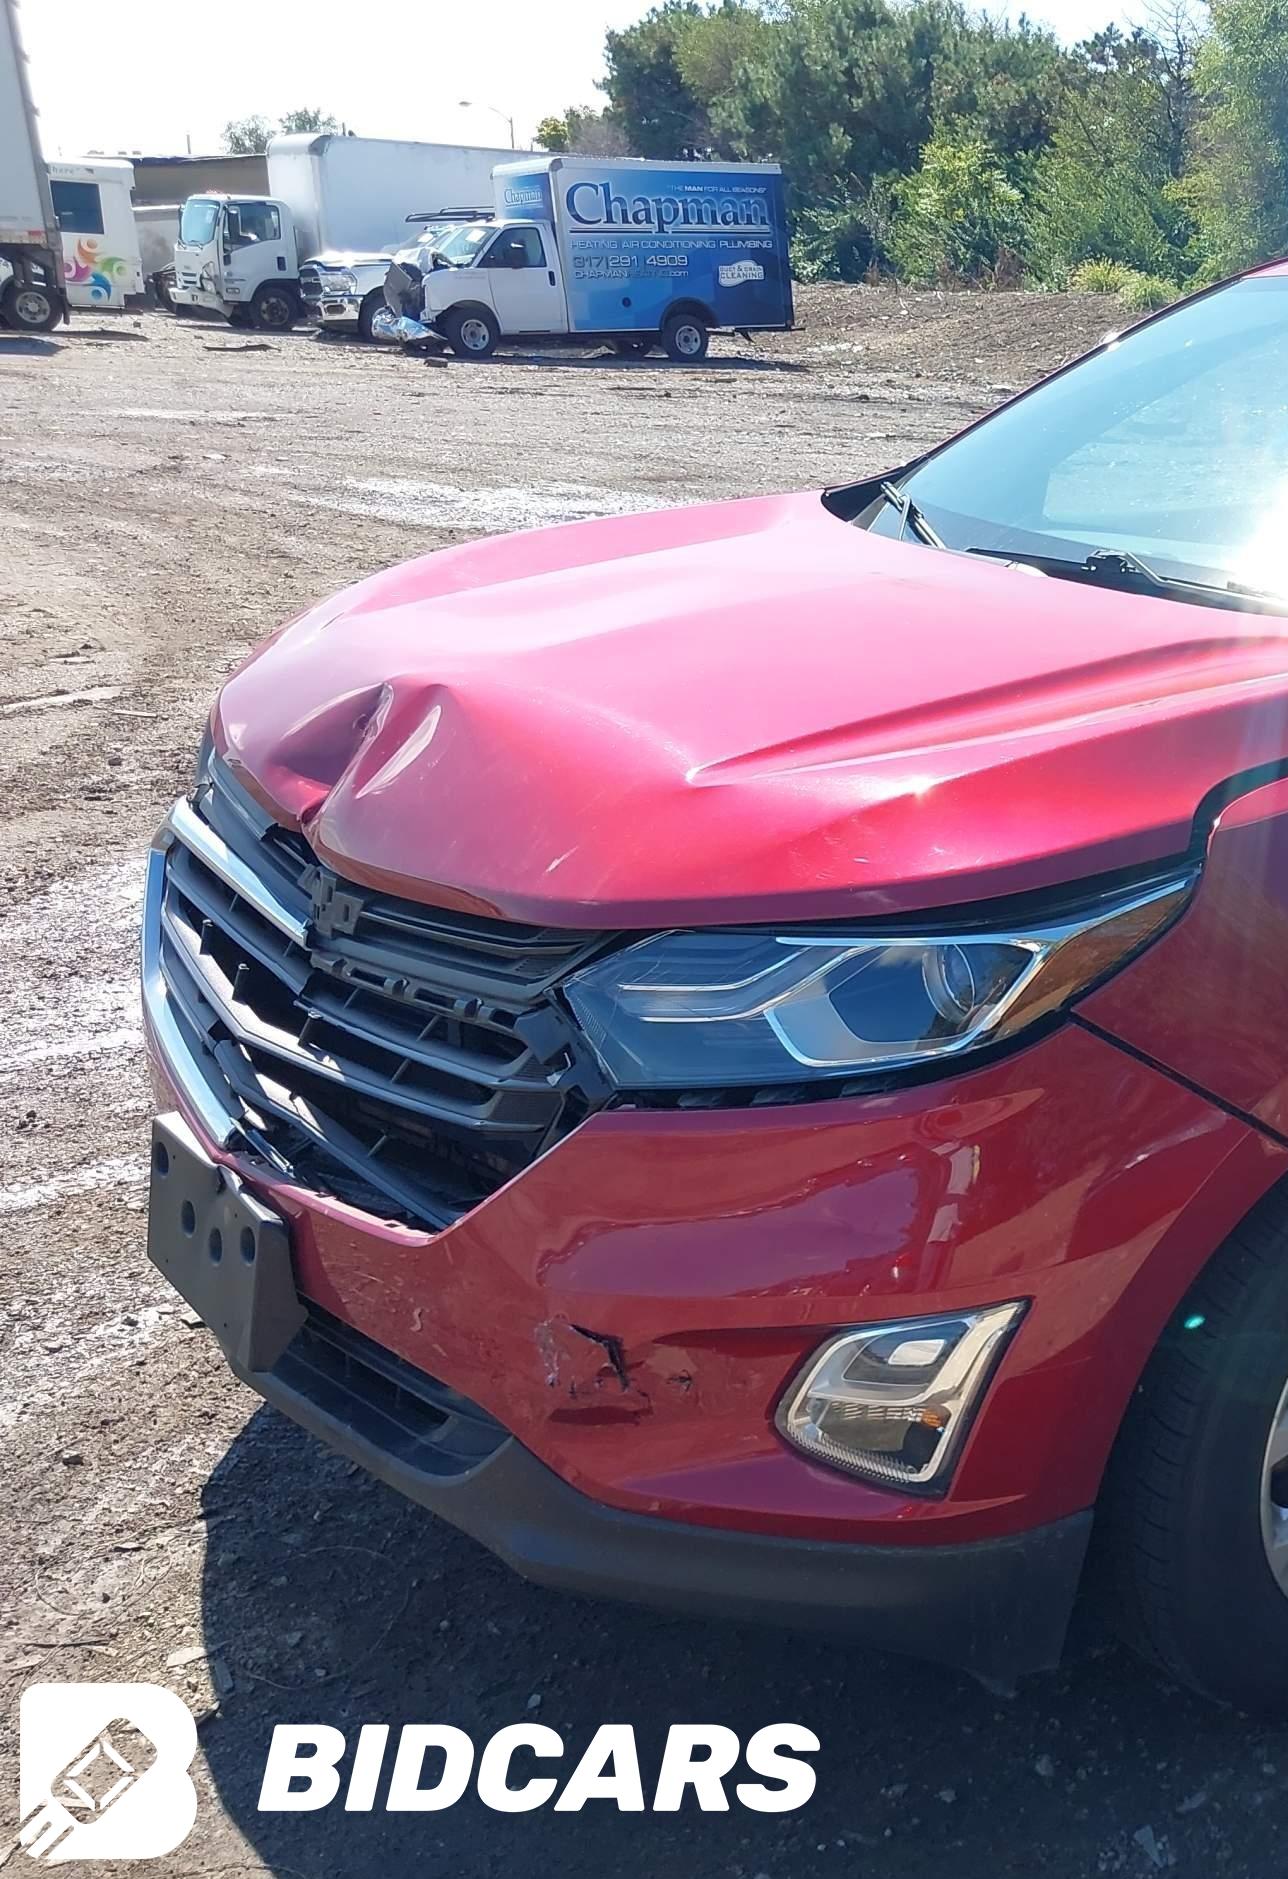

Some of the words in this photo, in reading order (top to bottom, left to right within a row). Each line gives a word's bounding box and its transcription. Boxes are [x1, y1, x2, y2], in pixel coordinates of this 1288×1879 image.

[684, 185, 703, 193] MAN
[566, 182, 770, 234] Chapman
[569, 240, 618, 249] HEATING
[621, 240, 640, 249] AIR
[641, 240, 716, 249] CONDITIONING
[720, 240, 773, 249] PLUMBING
[646, 256, 689, 267] 4909
[720, 271, 764, 279] CLEANING
